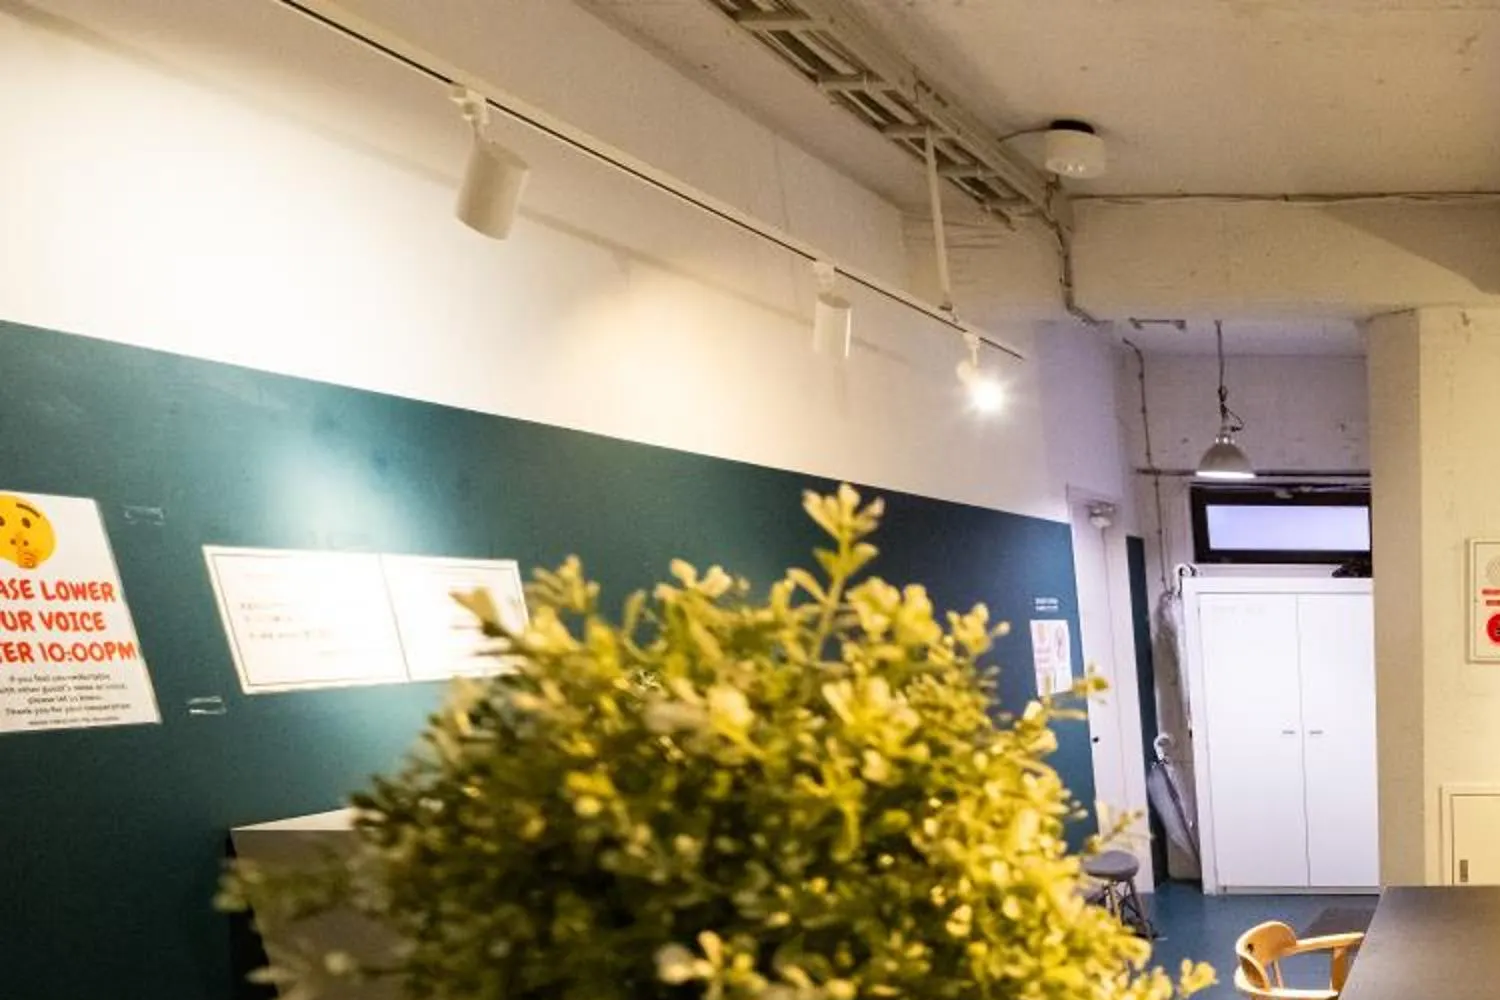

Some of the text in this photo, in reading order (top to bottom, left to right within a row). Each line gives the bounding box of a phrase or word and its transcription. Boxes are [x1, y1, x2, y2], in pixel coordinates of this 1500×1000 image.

[40, 580, 115, 602] LOWER
[39, 611, 105, 632] VOICE
[38, 642, 136, 662] 10:00PM
